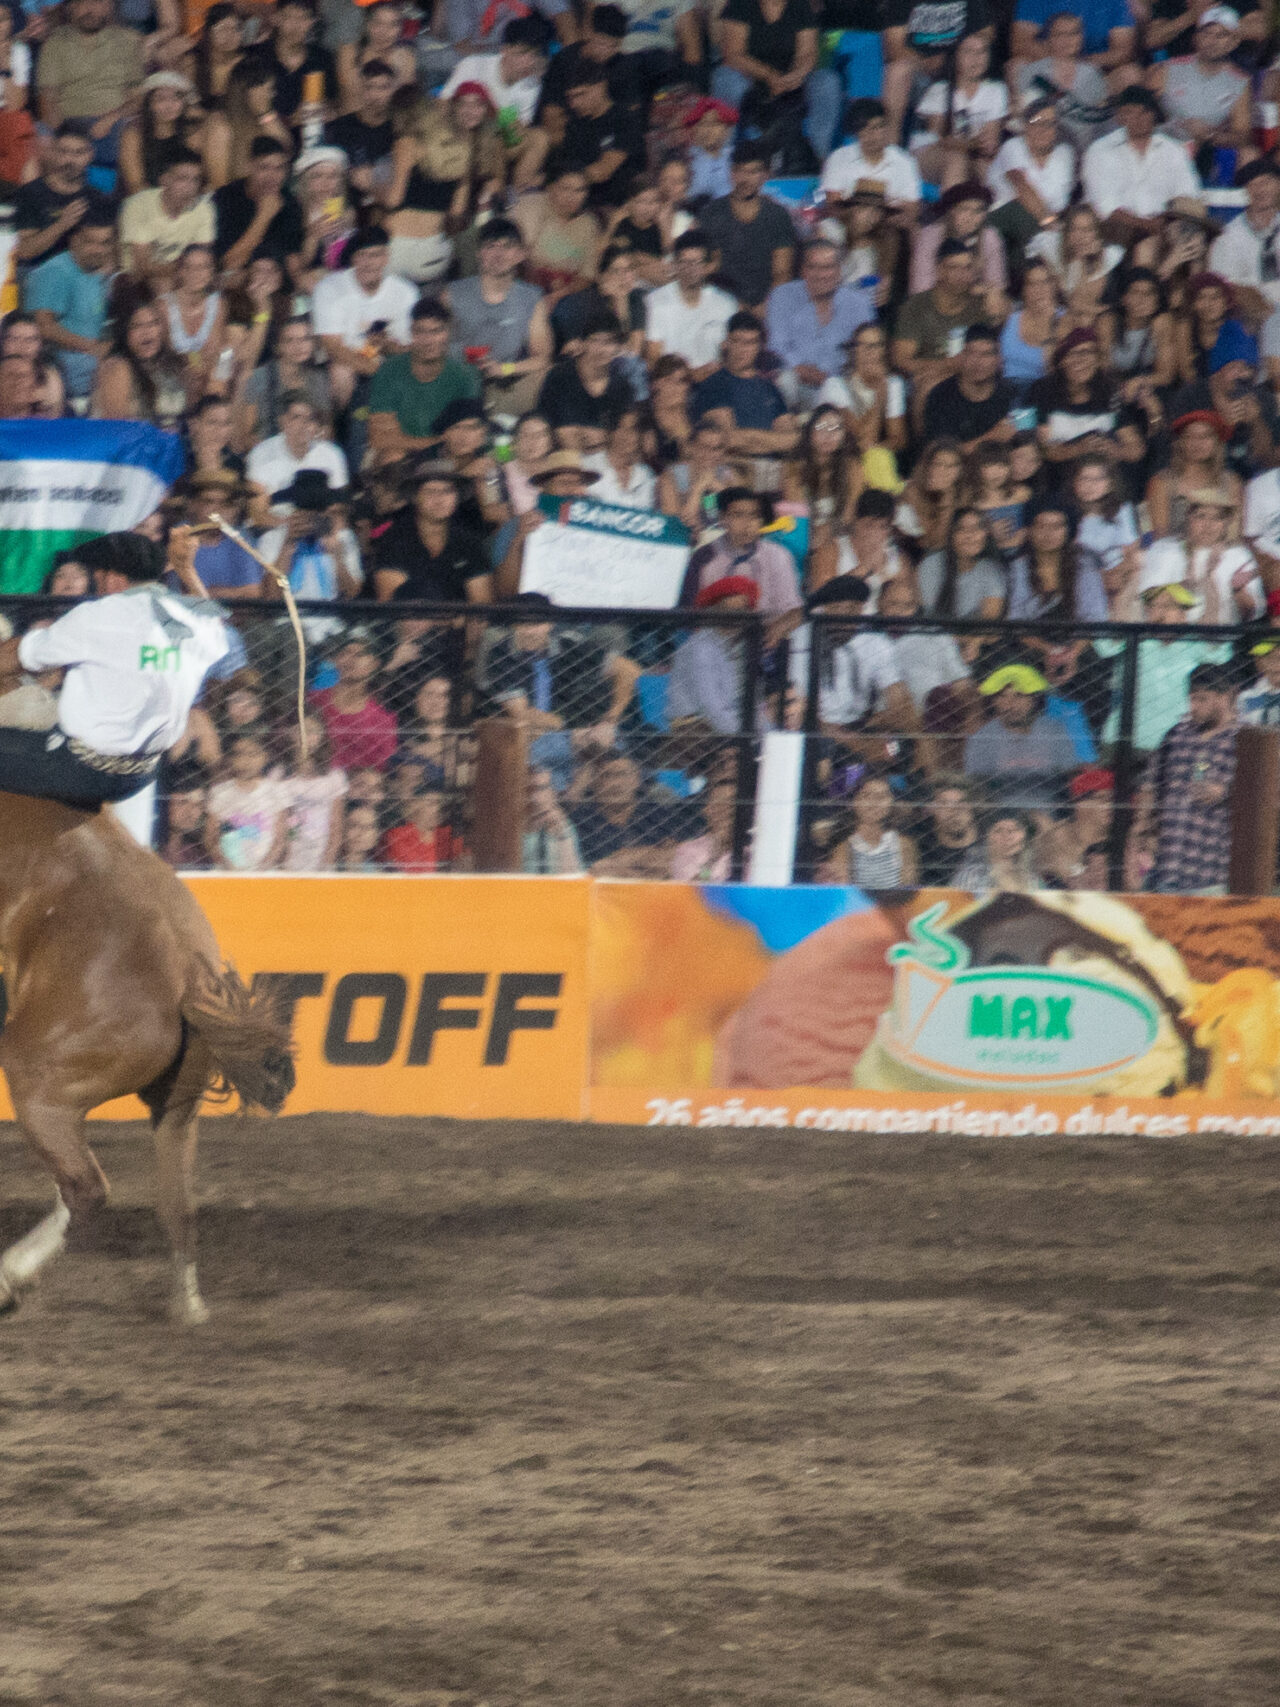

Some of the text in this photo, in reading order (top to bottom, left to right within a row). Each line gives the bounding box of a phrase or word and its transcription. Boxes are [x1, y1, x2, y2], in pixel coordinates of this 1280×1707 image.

[969, 994, 1073, 1040] MAX
[697, 1097, 789, 1128] años
[795, 1101, 1059, 1136] compartiendo
[1065, 1105, 1189, 1136] dulces
